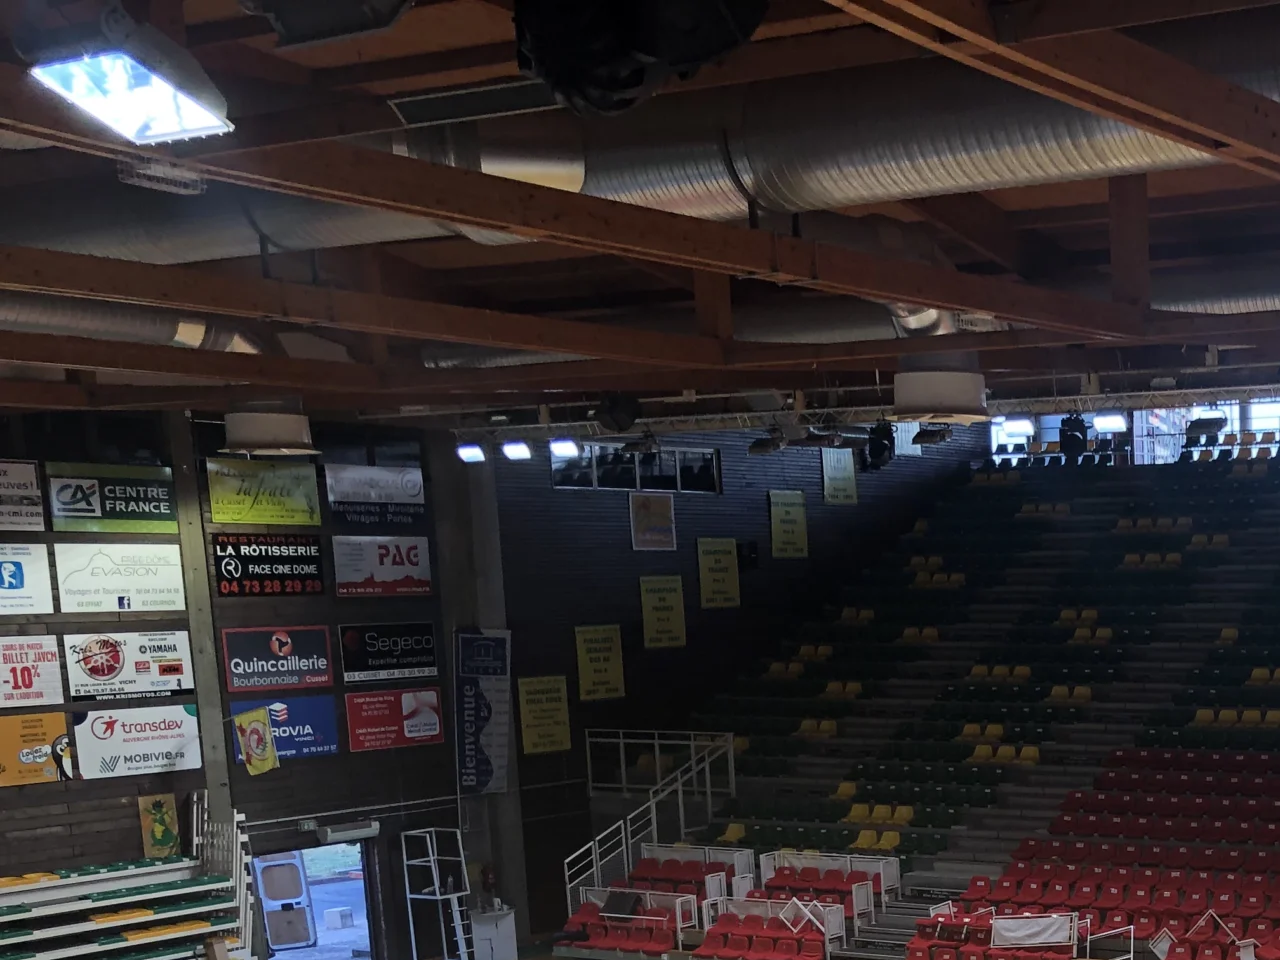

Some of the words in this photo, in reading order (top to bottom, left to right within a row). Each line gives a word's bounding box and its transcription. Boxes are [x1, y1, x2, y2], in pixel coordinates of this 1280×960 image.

[104, 485, 169, 499] CENTRE
[105, 500, 171, 513] FRANCE
[216, 545, 236, 556] LA
[240, 543, 319, 556] RÔTISSERIE
[90, 567, 159, 577] EVASION
[248, 564, 271, 574] FACE
[272, 564, 292, 574] CINE
[293, 564, 318, 574] DOME
[64, 588, 92, 596] Voyages
[220, 581, 239, 593] 04
[242, 580, 260, 593] 73
[263, 580, 282, 593] 28
[147, 644, 178, 653] YAMAHA
[365, 632, 434, 655] Segeco
[2, 652, 29, 665] BILLET
[32, 651, 58, 663] JAVCM
[230, 655, 328, 674] Quincaillerie
[233, 674, 299, 687] Bourbonnaise
[120, 718, 183, 734] transdev
[270, 724, 314, 738] ROVIA
[462, 684, 477, 786] Bienvenue
